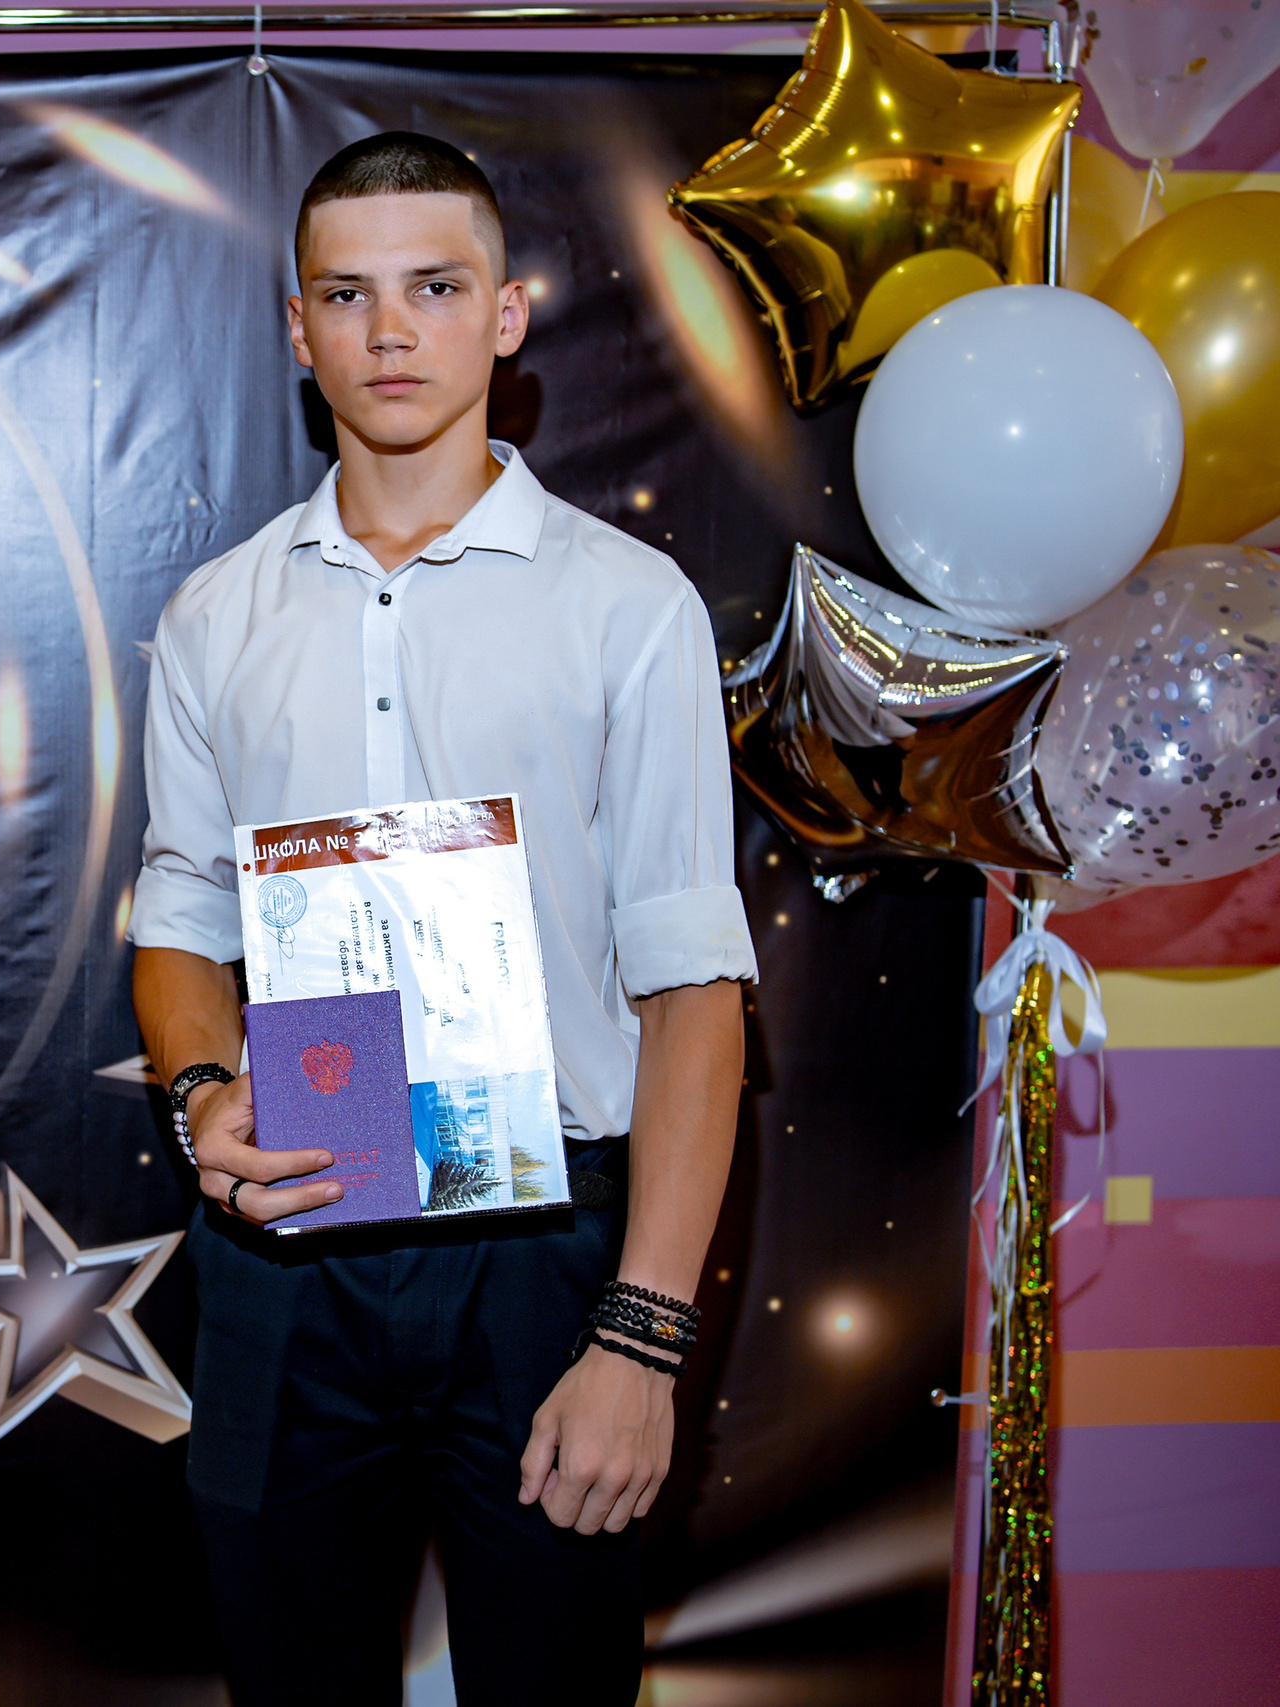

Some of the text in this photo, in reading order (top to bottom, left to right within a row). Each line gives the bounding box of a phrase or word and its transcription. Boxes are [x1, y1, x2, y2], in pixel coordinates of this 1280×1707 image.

[254, 838, 322, 862] ШКОЛА
[326, 833, 350, 851] №
[381, 919, 389, 930] за
[339, 940, 352, 994] образа жи
[382, 933, 395, 981] активное
[490, 921, 512, 994] ГРАМОТ
[334, 1150, 380, 1165] СТАТ
